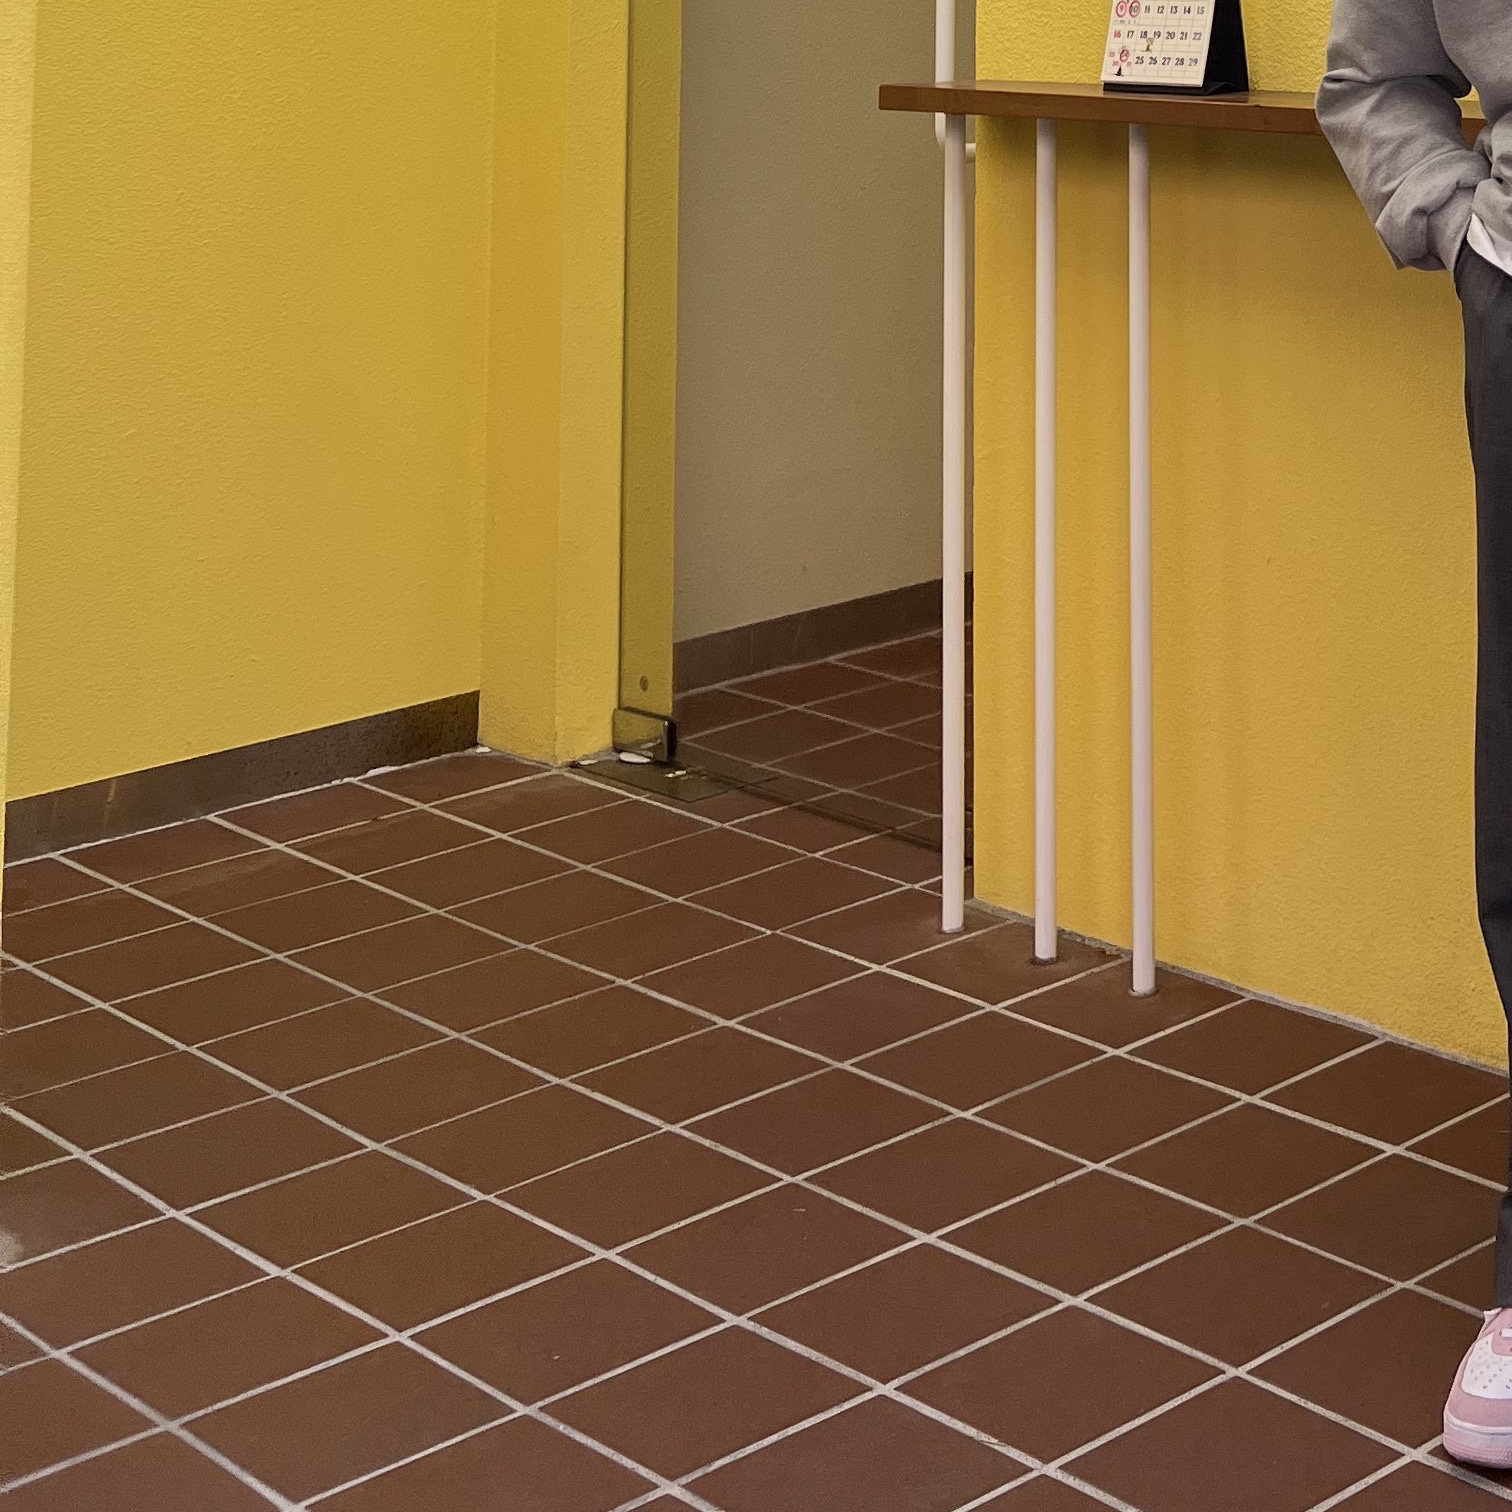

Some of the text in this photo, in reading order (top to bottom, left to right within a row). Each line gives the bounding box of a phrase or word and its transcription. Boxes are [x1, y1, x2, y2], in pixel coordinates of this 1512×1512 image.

[1143, 5, 1151, 14] 11
[1156, 5, 1165, 14] 12
[1170, 5, 1178, 14] 13
[1183, 5, 1191, 15] 14
[1196, 5, 1205, 15] 15
[1126, 29, 1135, 39] 17
[1140, 30, 1148, 39] 18
[1153, 30, 1162, 39] 19
[1165, 30, 1176, 40] 20
[1179, 31, 1188, 41] 21
[1192, 31, 1202, 41] 22
[1134, 55, 1144, 65] 25
[1161, 56, 1171, 66] 27
[1174, 57, 1185, 66] 28
[1188, 57, 1198, 67] 29
